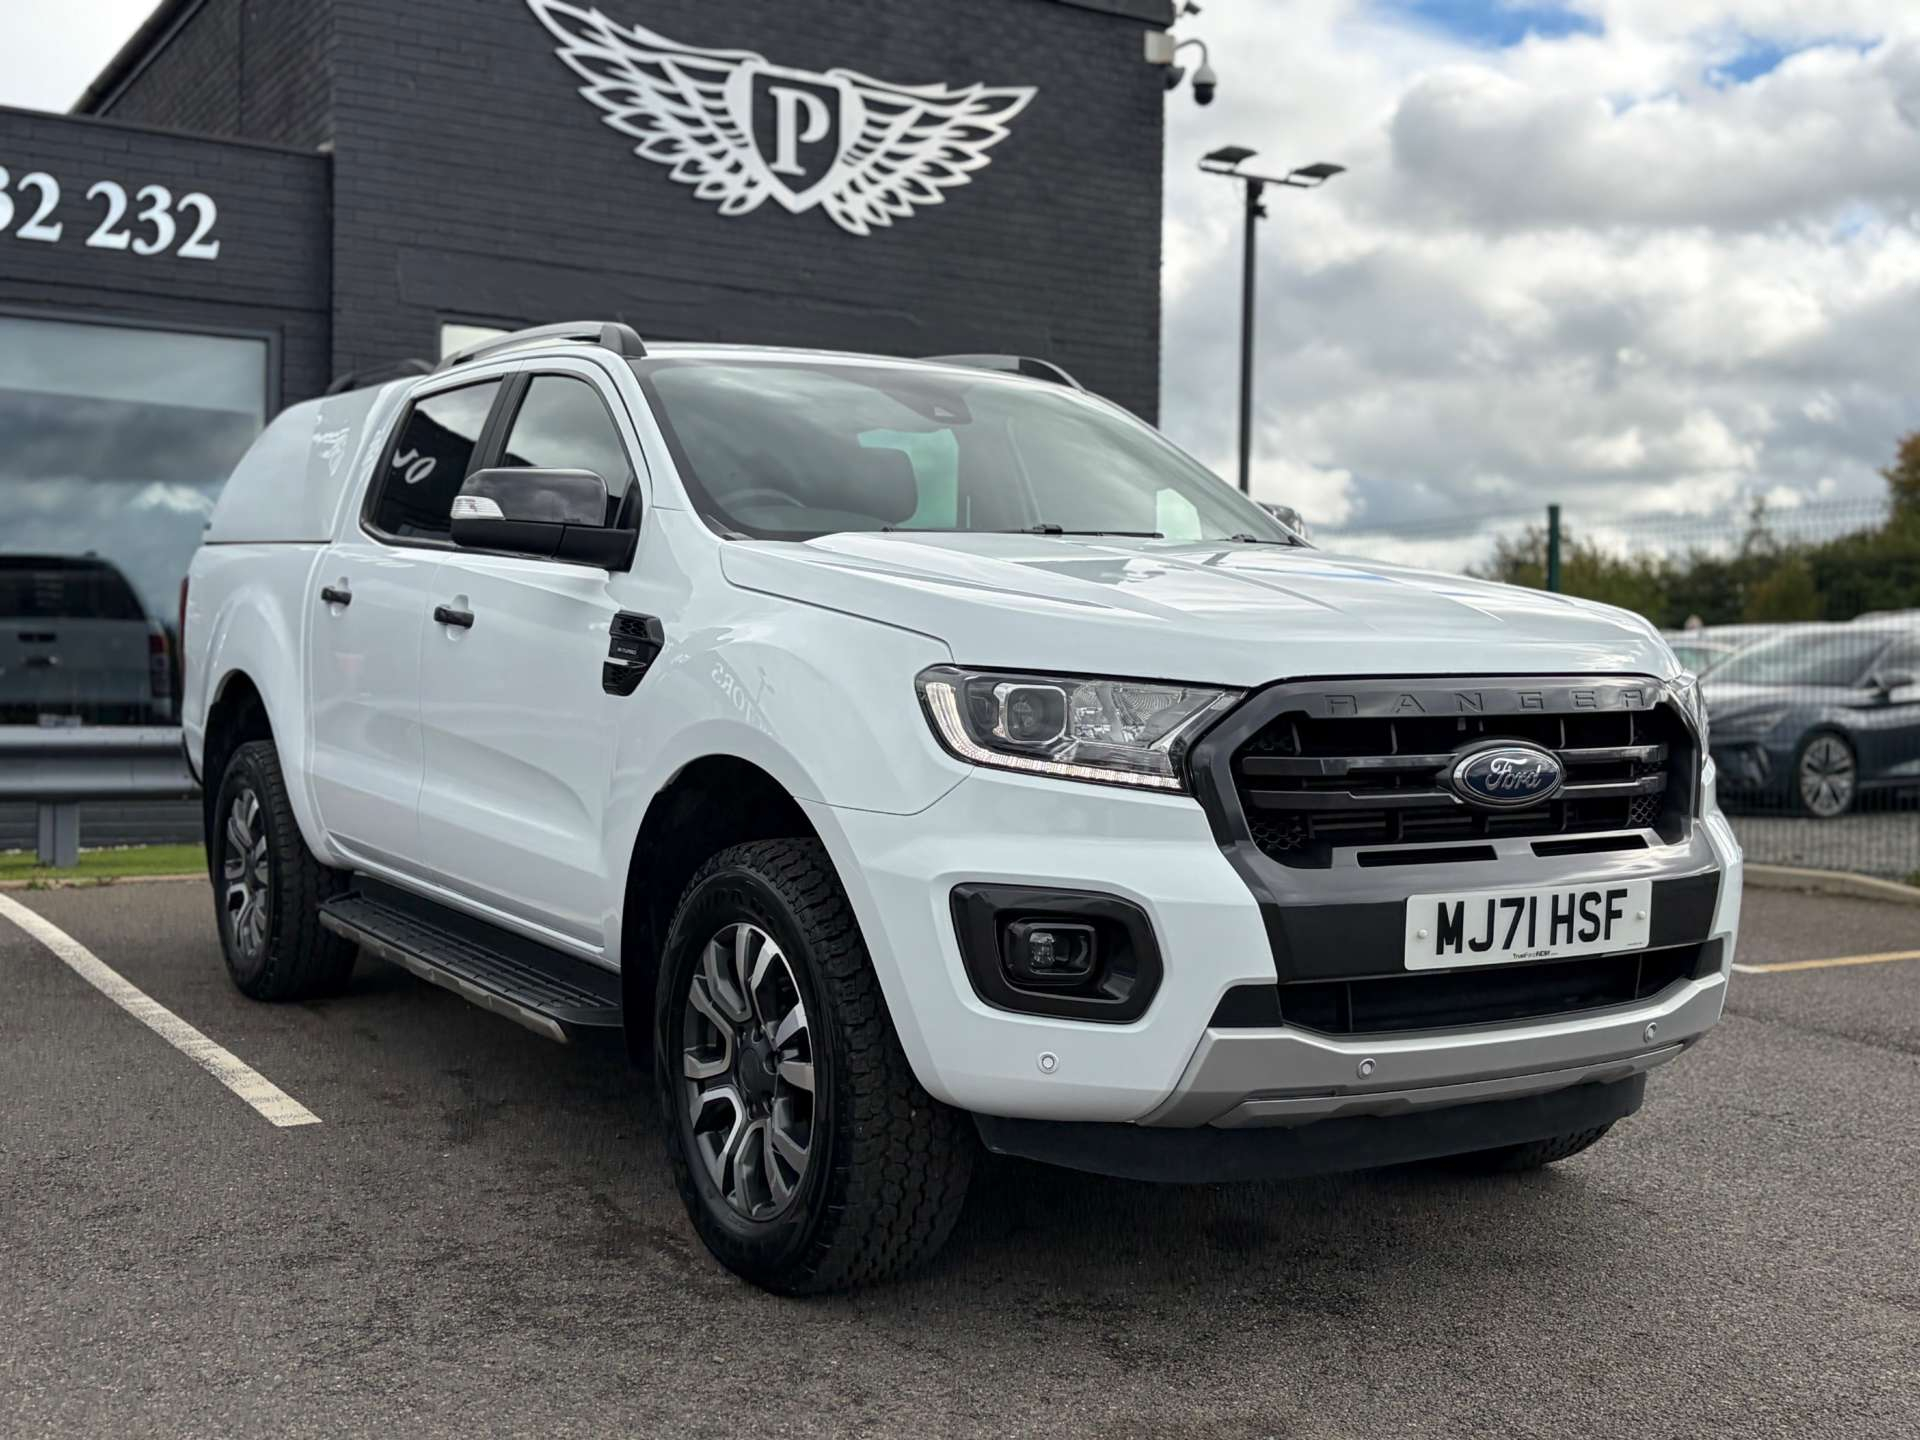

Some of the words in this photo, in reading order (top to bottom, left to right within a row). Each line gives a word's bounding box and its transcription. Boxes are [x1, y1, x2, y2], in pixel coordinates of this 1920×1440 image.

[767, 86, 830, 176] P
[85, 180, 221, 260] 232
[1323, 688, 1645, 715] RANGER
[1485, 757, 1541, 790] Ford
[1436, 896, 1537, 955] MJ71
[1550, 888, 1628, 946] HSF
